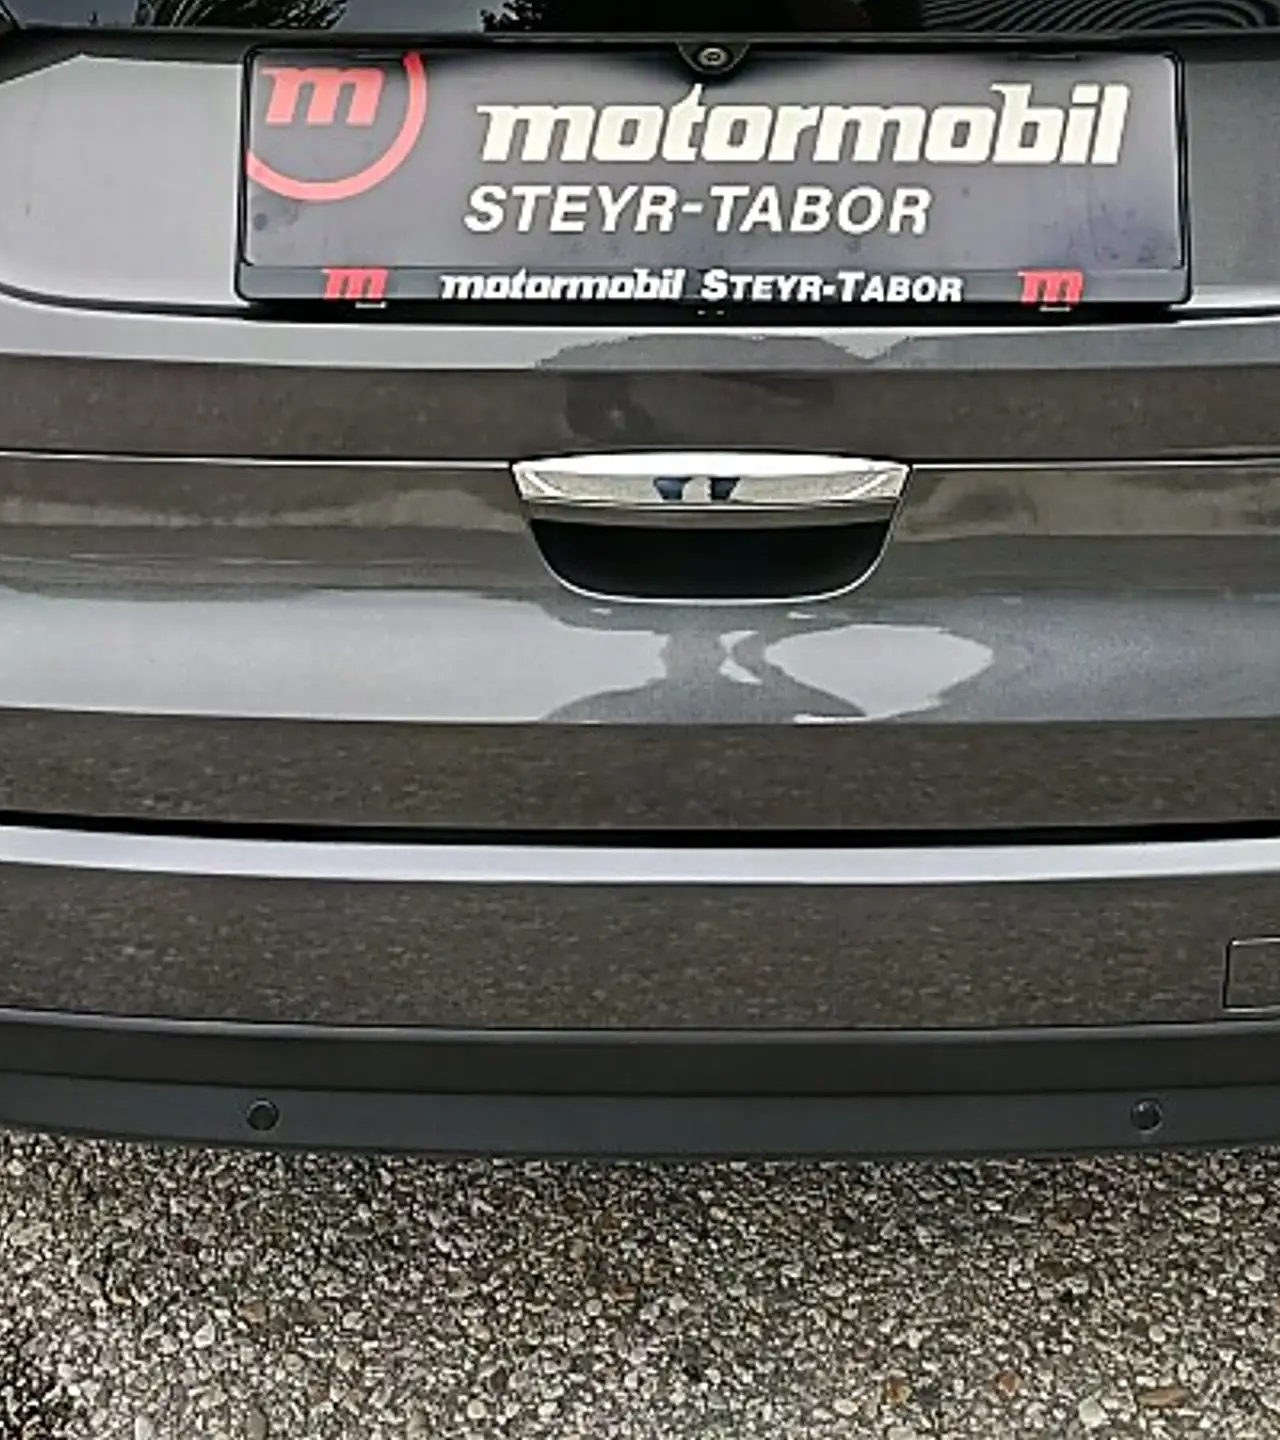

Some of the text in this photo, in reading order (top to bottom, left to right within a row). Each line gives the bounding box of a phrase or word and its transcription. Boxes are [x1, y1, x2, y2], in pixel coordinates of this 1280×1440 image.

[475, 81, 1130, 167] motormobil
[463, 184, 934, 237] STEYR-TABOR
[439, 268, 965, 305] motormobil STEYR-TABOR
